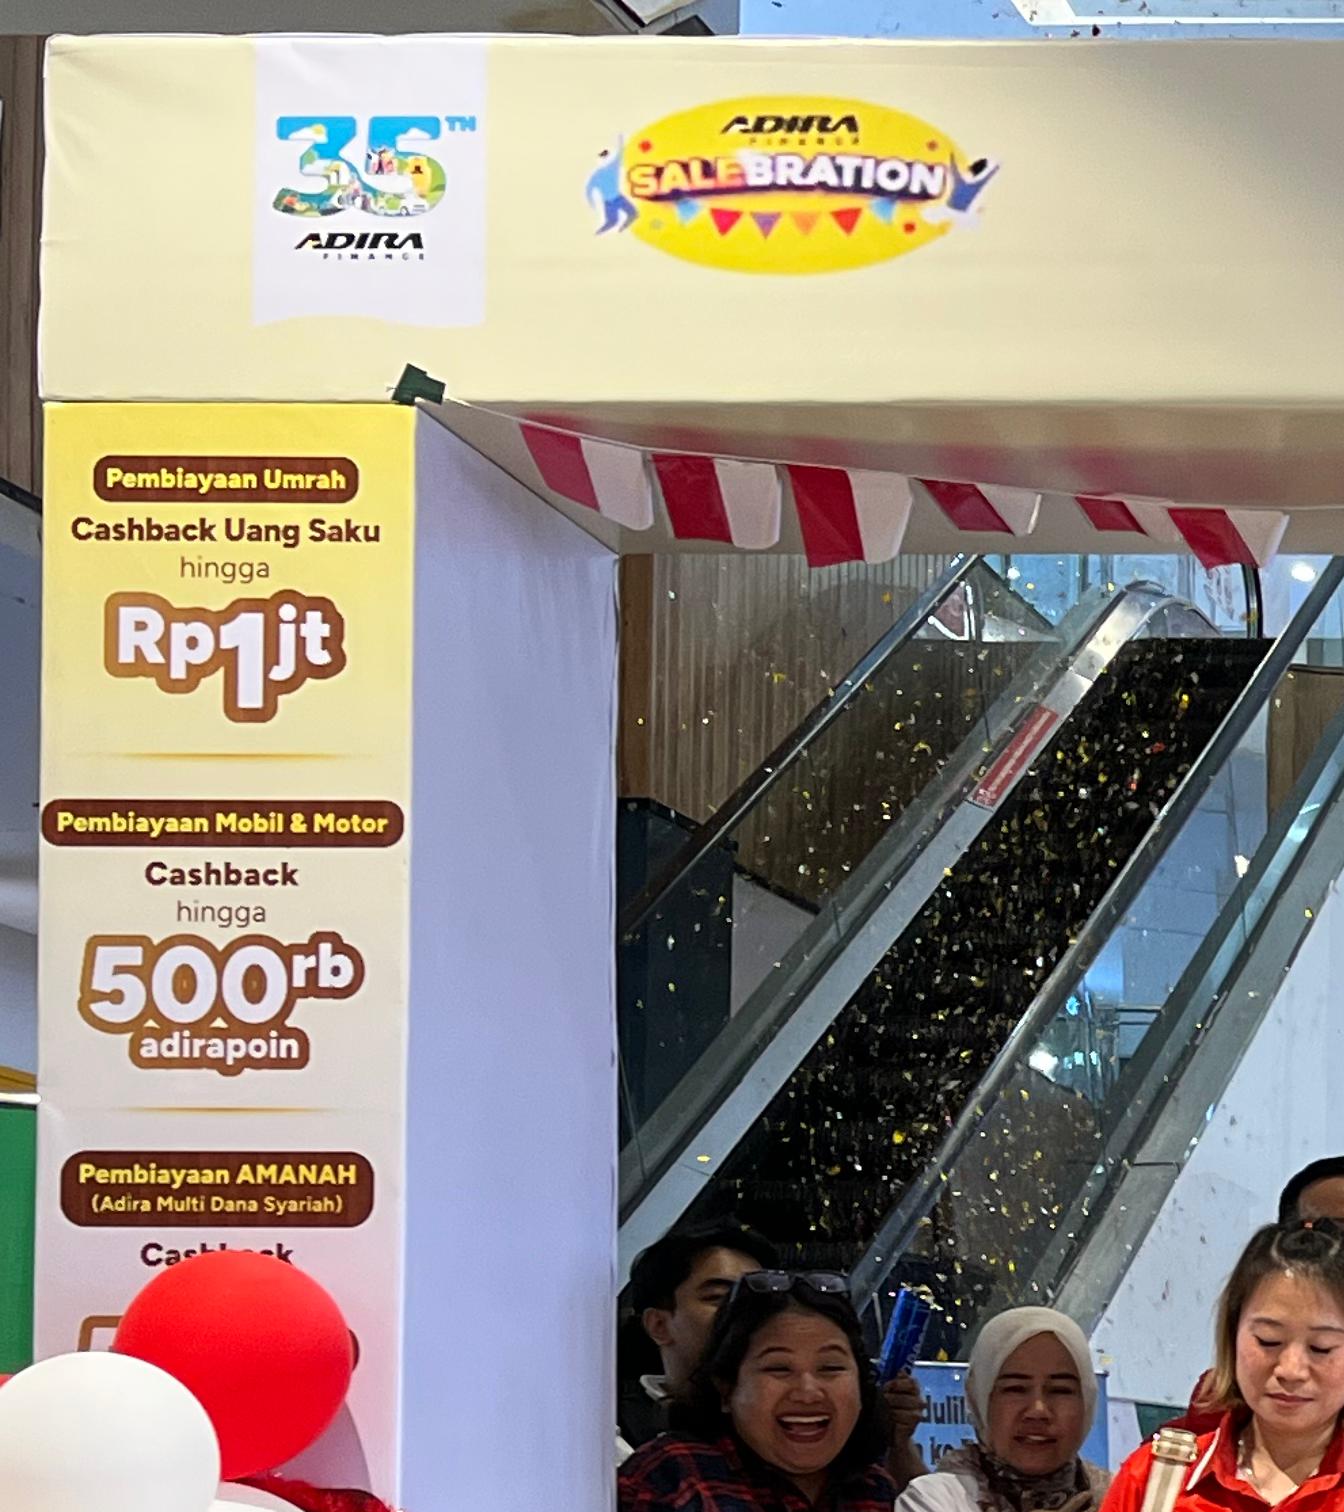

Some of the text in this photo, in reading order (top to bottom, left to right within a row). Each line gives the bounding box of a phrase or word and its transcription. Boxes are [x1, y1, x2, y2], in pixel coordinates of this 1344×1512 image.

[720, 114, 860, 135] ADIRA
[627, 153, 949, 201] SALEBRATION
[294, 233, 425, 250] ADIRA
[106, 467, 346, 494] Pembiayaan Umrah
[71, 517, 381, 548] Cashback Uang Saku
[180, 556, 270, 584] hingga
[56, 811, 388, 837] Pembiayaan Mobil & Motor
[145, 861, 300, 886] Cashback
[176, 900, 266, 927] hingga
[139, 1031, 300, 1065] adirapoin
[78, 1163, 357, 1189] Pembiayaan AMANAH
[91, 1195, 343, 1214] (Adira Multi Dana Syariah)
